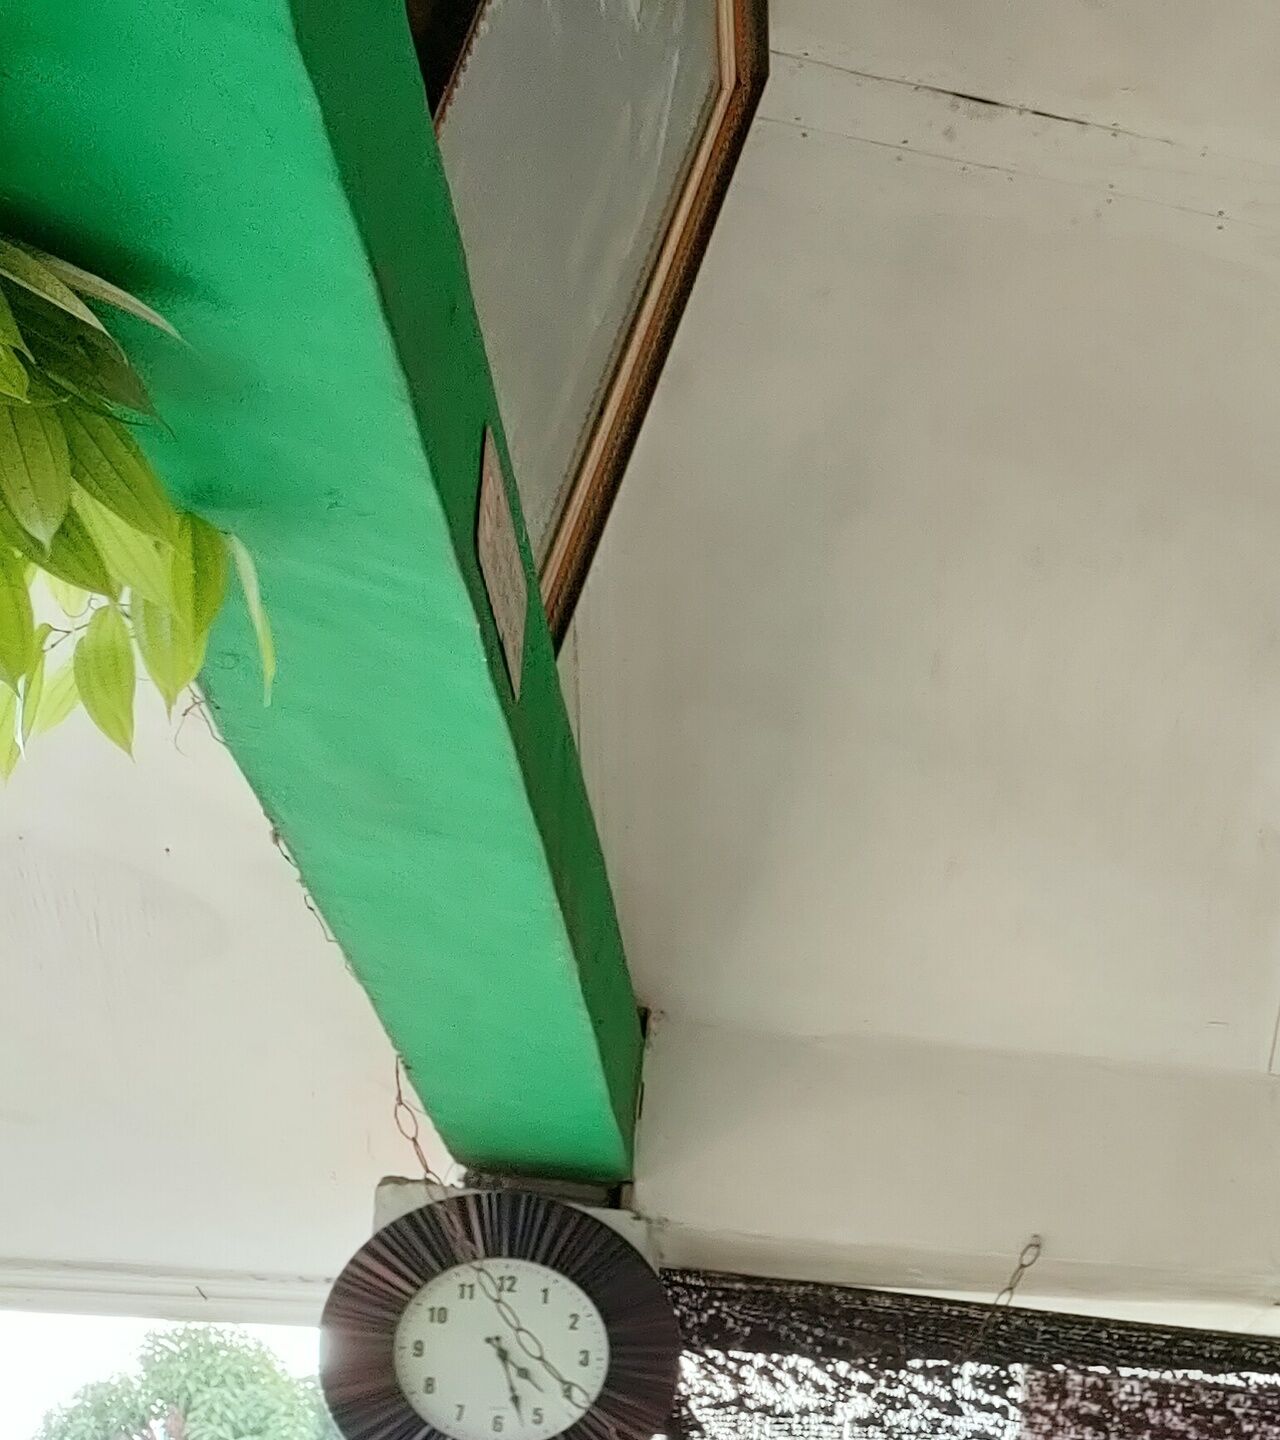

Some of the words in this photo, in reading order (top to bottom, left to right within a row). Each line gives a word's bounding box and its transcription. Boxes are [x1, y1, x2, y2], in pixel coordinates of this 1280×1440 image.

[458, 1283, 475, 1300] 11
[498, 1276, 518, 1293] 12
[541, 1287, 550, 1304] 1
[428, 1306, 448, 1324] 10
[568, 1313, 580, 1330] 2
[412, 1340, 424, 1357] 9
[578, 1350, 590, 1367] 3
[423, 1377, 435, 1394] 8
[455, 1404, 466, 1421] 7
[531, 1407, 543, 1425] 5
[492, 1415, 504, 1432] 6
